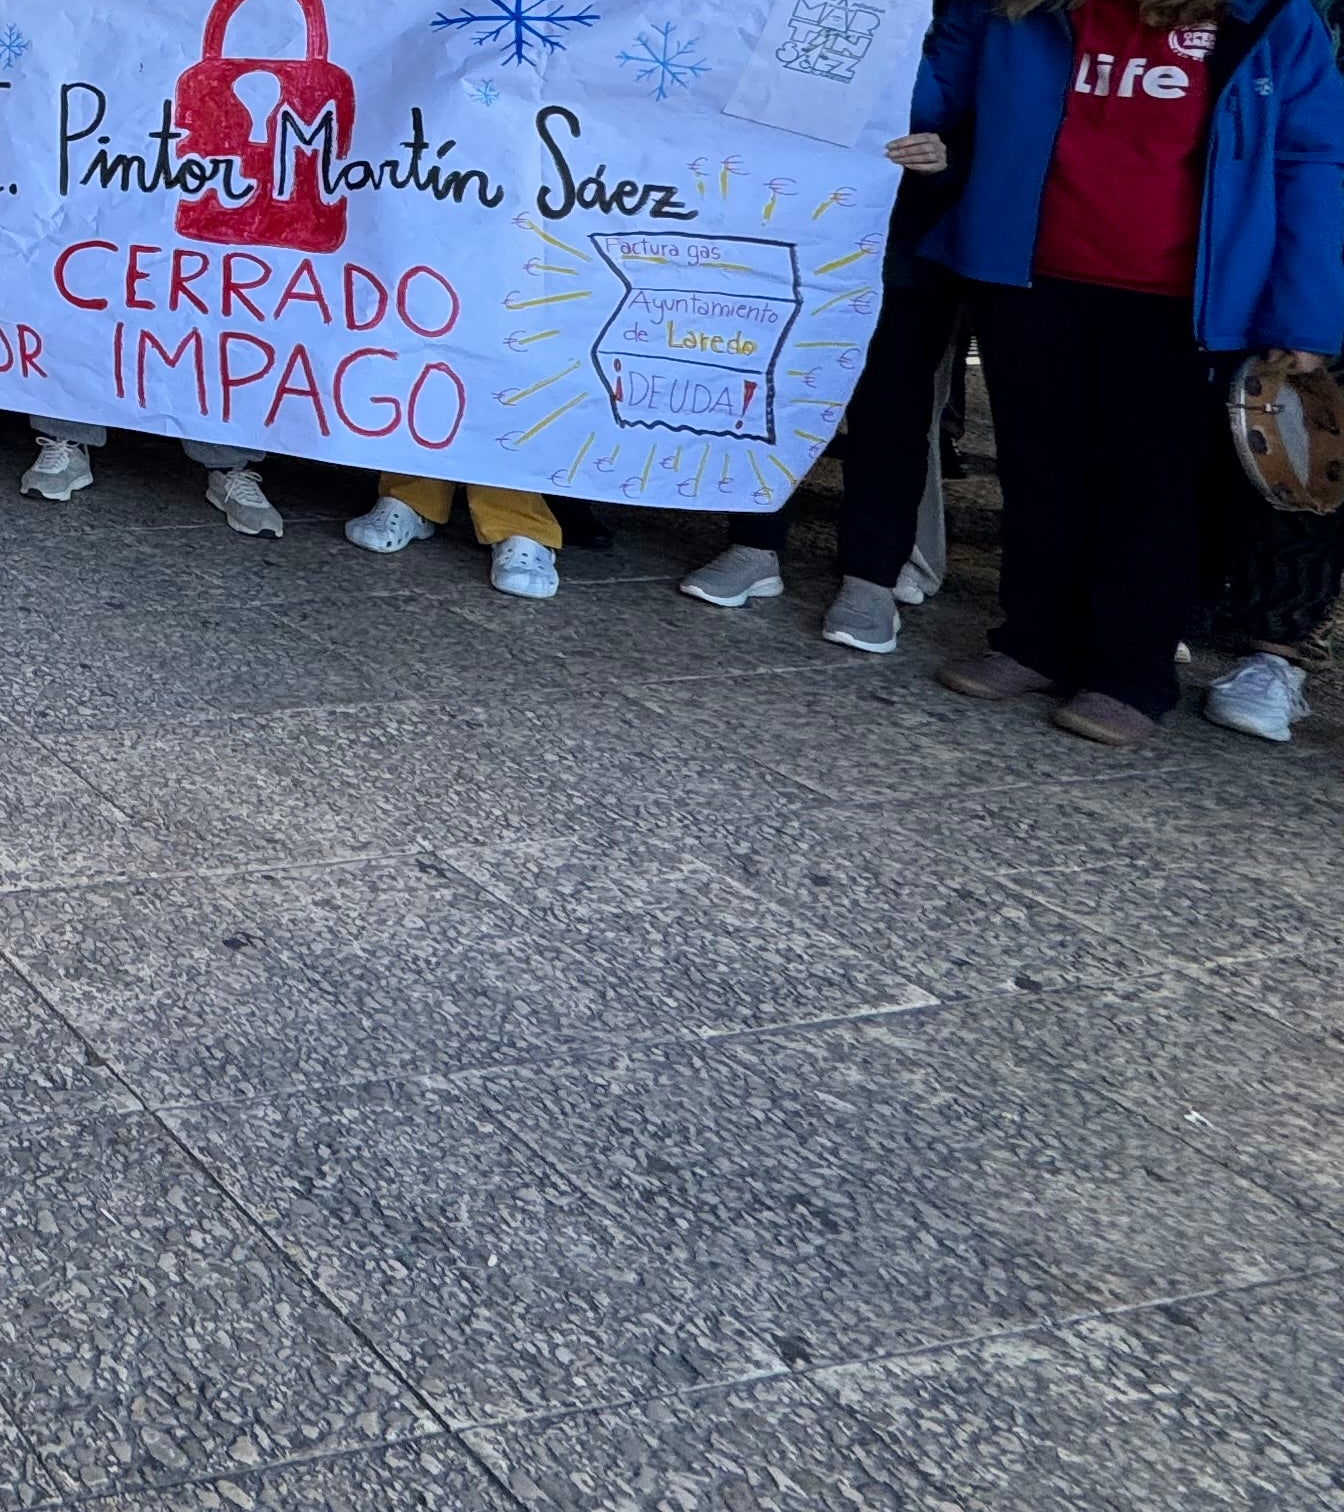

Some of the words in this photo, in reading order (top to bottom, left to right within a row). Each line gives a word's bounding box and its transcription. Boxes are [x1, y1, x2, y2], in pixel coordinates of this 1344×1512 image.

[59, 82, 255, 201] Pintor
[277, 100, 504, 210] Martín
[535, 105, 699, 220] Sáez
[605, 237, 679, 258] Factura
[687, 245, 721, 266] gas
[54, 240, 460, 338] CERRADO
[627, 290, 779, 325] Ayuntamiento
[622, 321, 649, 342] de
[666, 320, 758, 356] Laredo
[114, 322, 465, 450] IMPAGO
